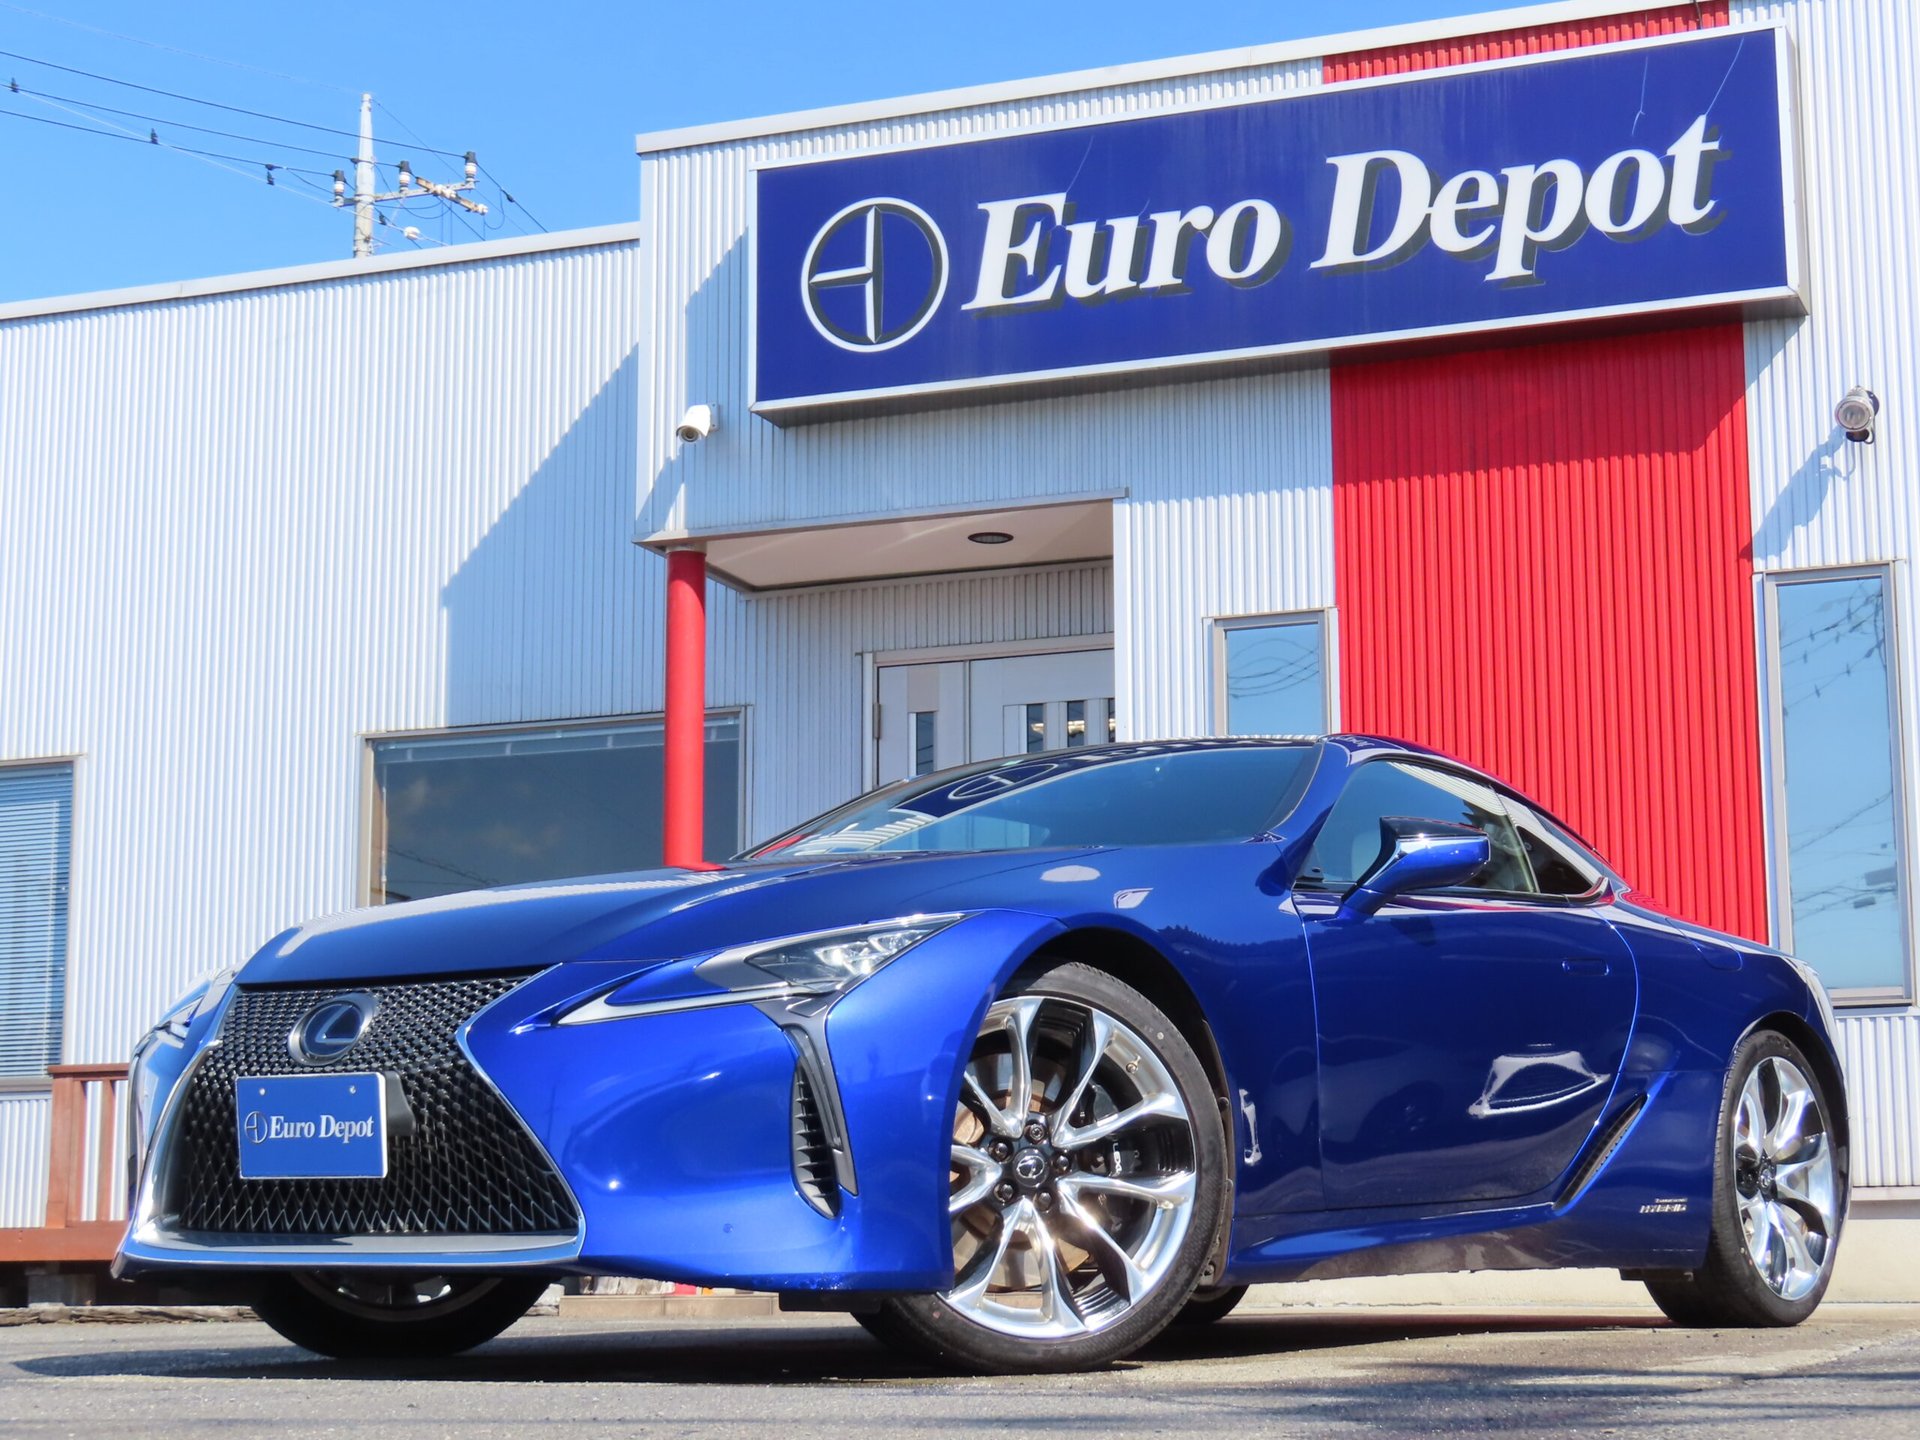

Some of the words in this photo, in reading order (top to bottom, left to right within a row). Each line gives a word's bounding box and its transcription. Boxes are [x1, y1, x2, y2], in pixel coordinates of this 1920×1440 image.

[960, 191, 1281, 311] Euro
[1309, 114, 1720, 282] Depot
[268, 1115, 315, 1139] Euro
[319, 1114, 374, 1144] Depot
